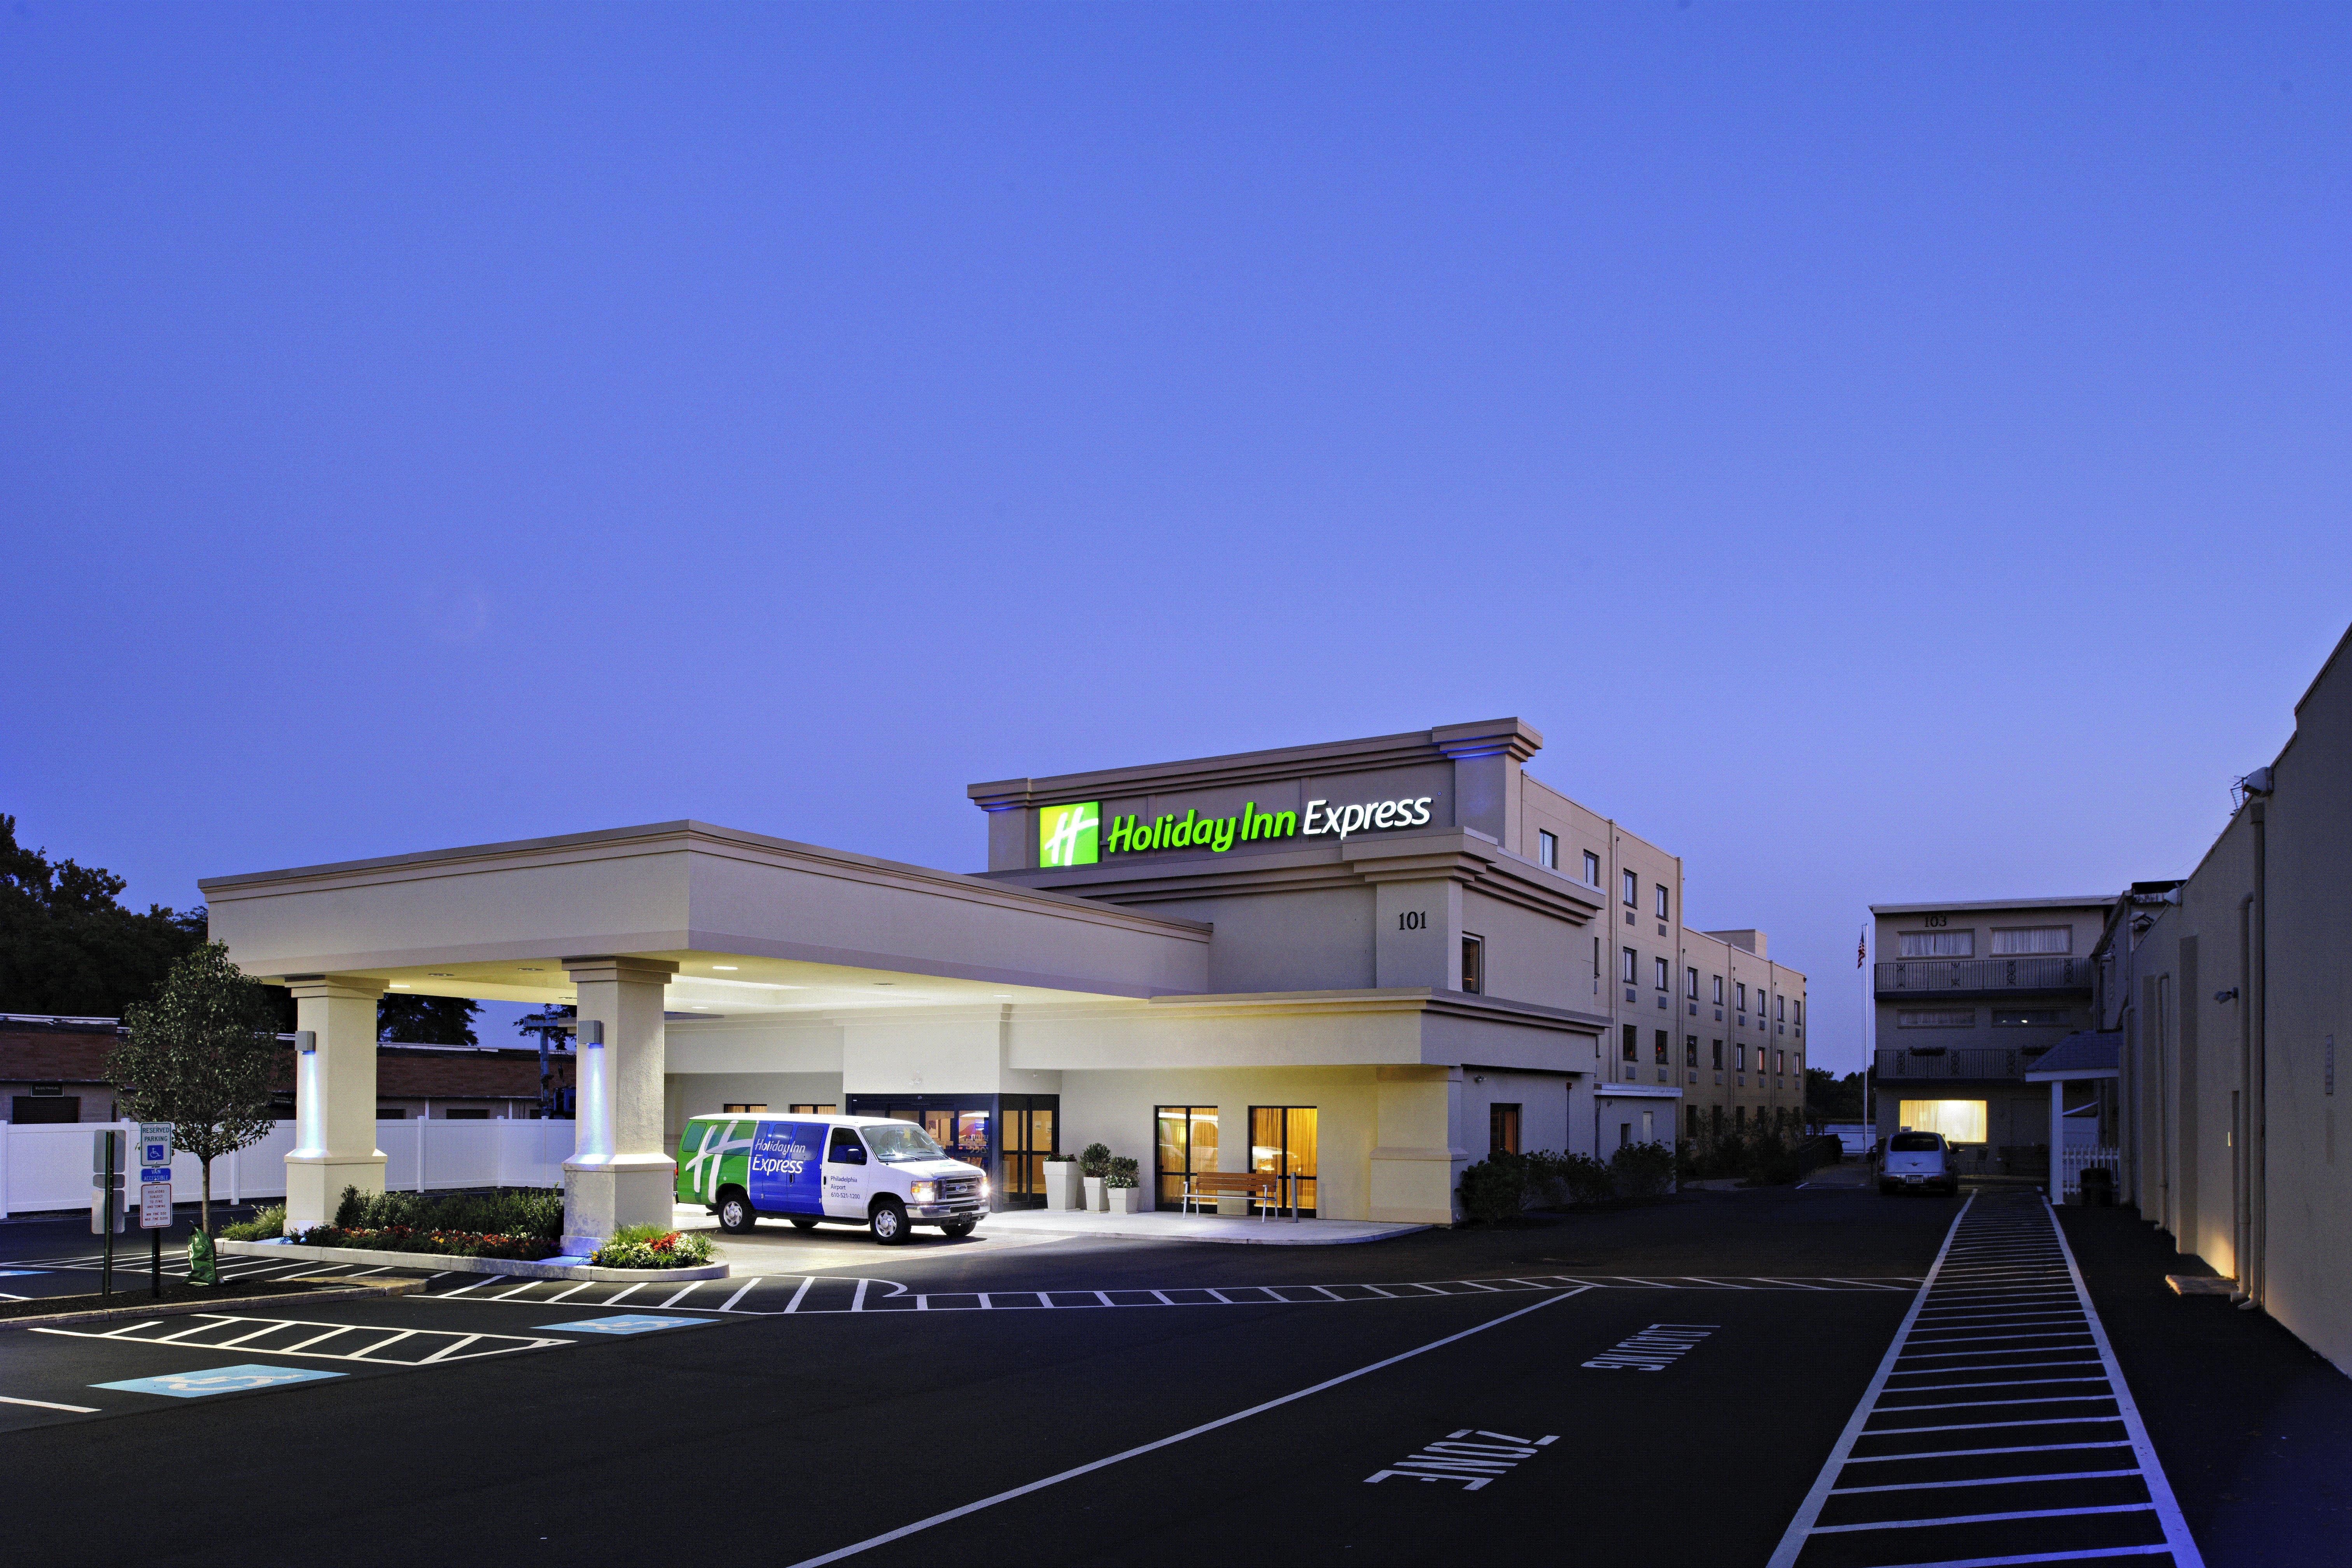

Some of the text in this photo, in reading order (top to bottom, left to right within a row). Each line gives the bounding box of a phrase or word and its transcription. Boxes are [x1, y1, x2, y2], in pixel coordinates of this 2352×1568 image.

[1107, 797, 1432, 852] Holiday Inn Express
[1398, 911, 1427, 930] 101
[1925, 915, 1946, 927] 103
[755, 1138, 806, 1155] Holiday Inn
[752, 1154, 804, 1176] Express
[1580, 1323, 1721, 1371] LOADING
[1363, 1429, 1560, 1490] ZONE
